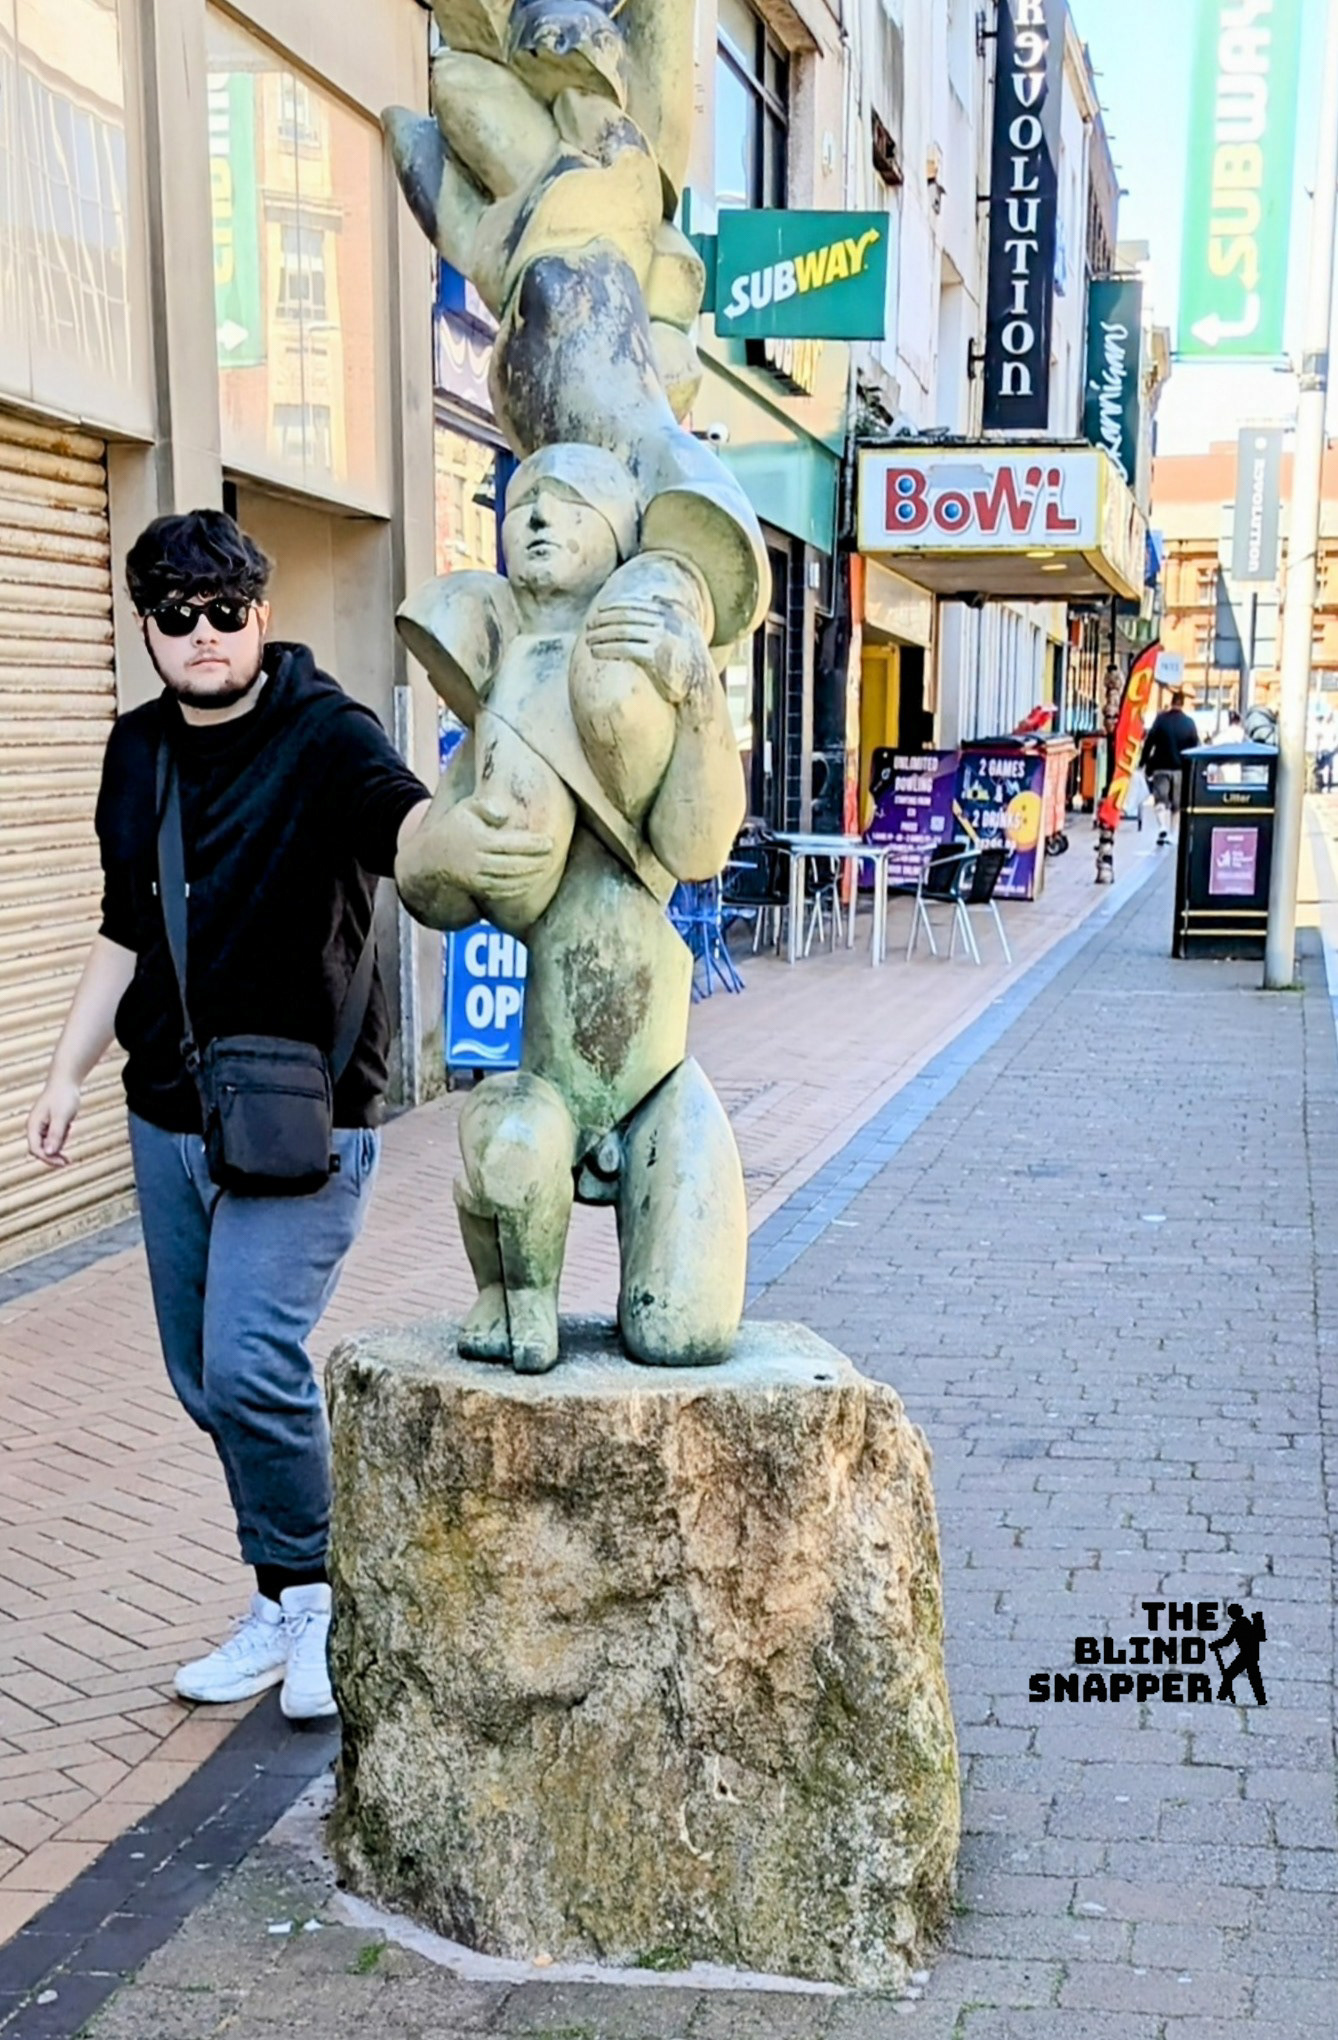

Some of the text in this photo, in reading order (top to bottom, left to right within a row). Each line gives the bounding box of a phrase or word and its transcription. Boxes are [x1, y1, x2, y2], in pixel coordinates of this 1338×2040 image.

[723, 228, 881, 320] SUBWAY
[978, 758, 1026, 778] 2 GAMES
[1223, 792, 1251, 803] Litter
[972, 809, 980, 828] 2
[464, 932, 528, 978] CHI
[465, 984, 524, 1030] OP
